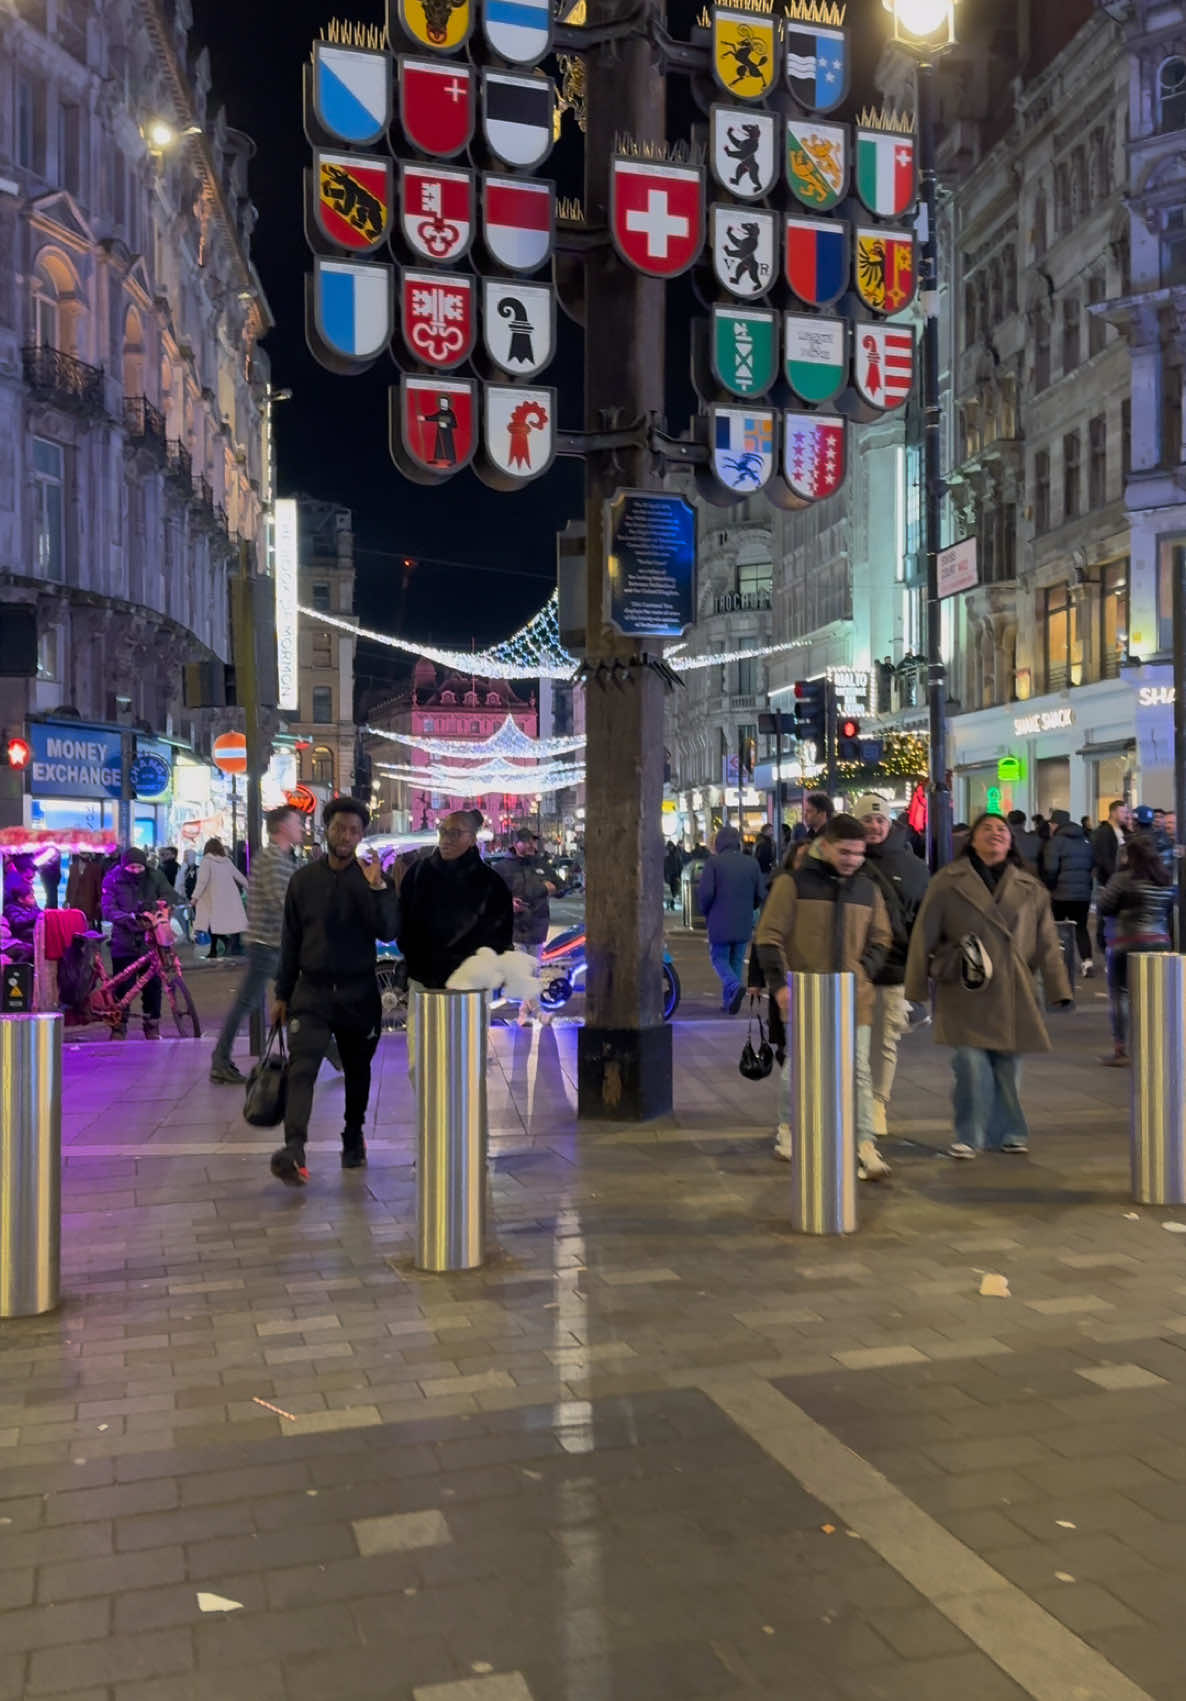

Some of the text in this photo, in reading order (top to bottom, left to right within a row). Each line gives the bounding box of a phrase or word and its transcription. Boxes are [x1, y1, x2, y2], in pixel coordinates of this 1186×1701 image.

[760, 263, 769, 275] R
[280, 625, 292, 697] MORMON
[47, 738, 107, 760] MONEY
[33, 762, 121, 786] EXCHANGE
